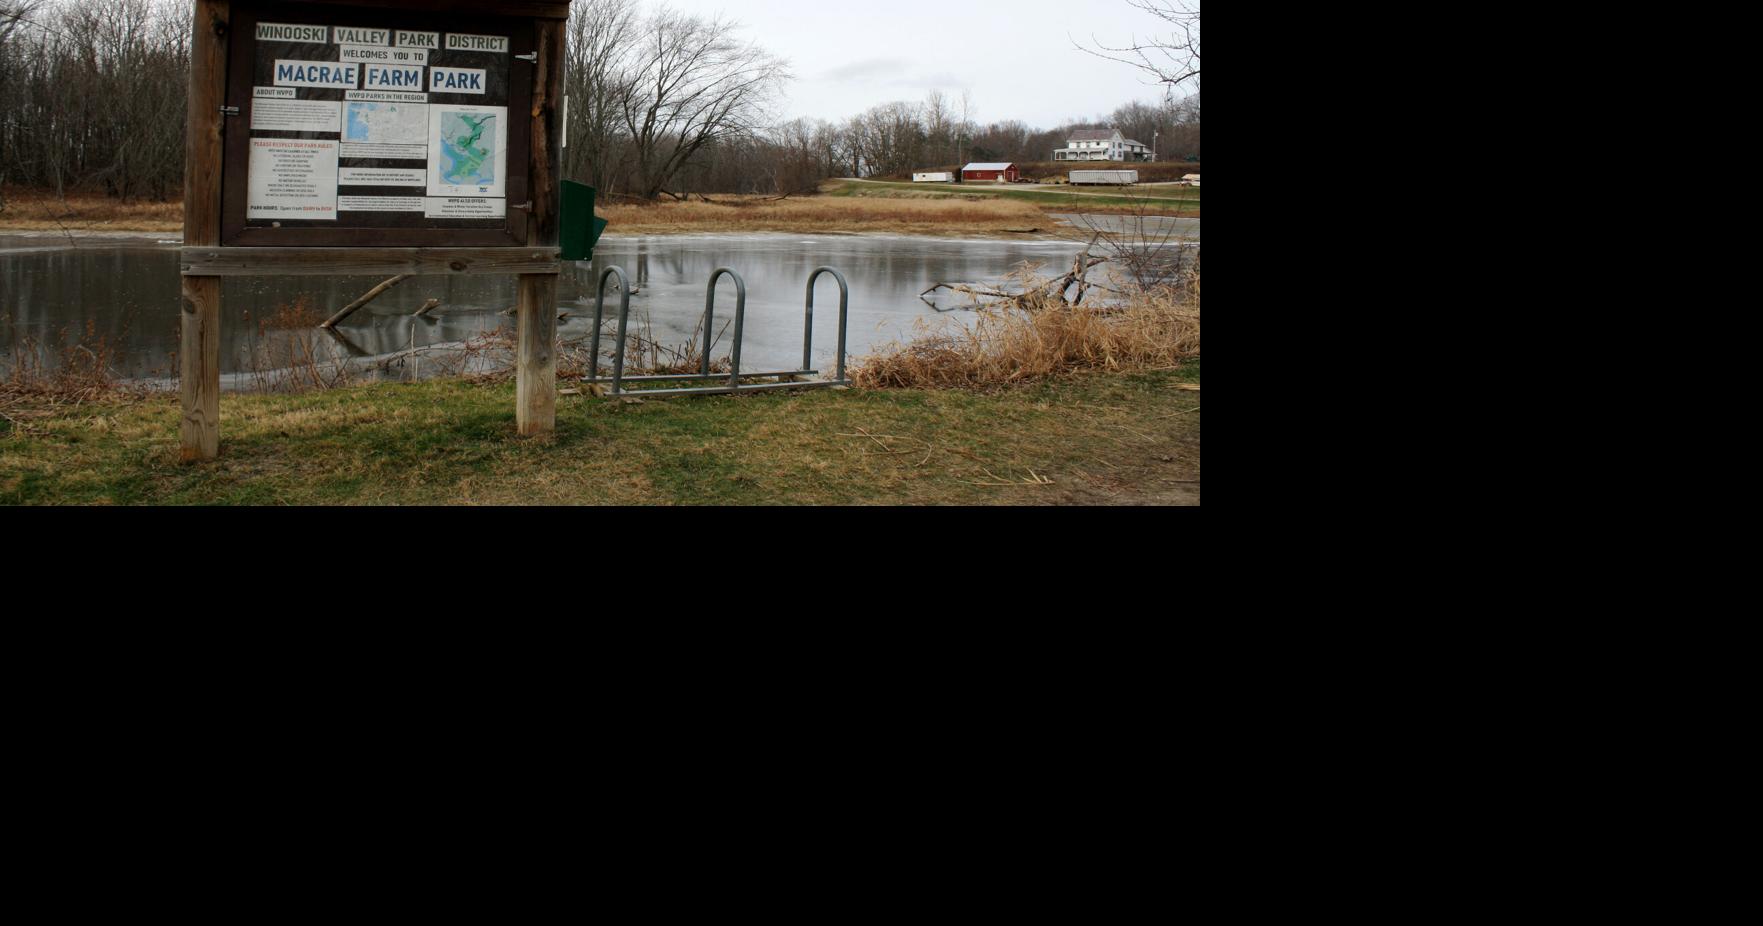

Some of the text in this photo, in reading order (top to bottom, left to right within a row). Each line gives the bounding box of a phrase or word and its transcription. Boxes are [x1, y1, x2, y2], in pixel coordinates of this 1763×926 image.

[256, 24, 506, 51] WINOOSKI VALLEY PARK DISTRICT
[343, 49, 424, 61] WELCOMES YOU TO
[278, 64, 481, 90] MACRAE FARM PARK
[366, 92, 386, 100] PARKS
